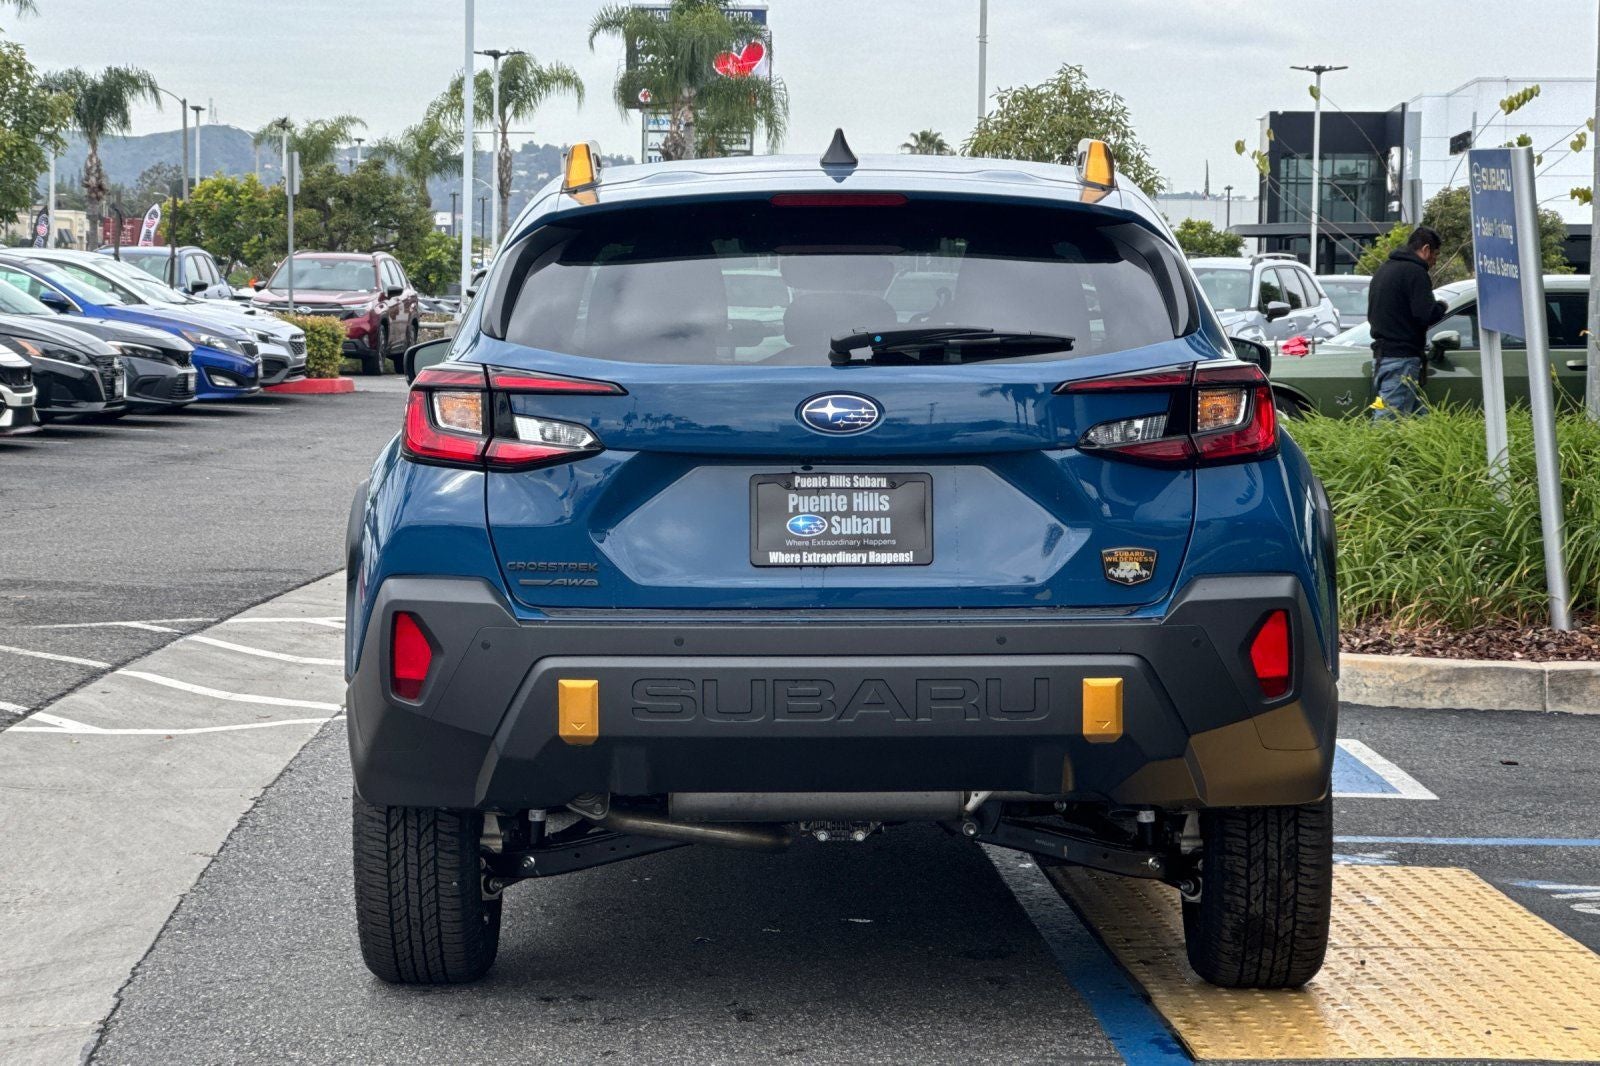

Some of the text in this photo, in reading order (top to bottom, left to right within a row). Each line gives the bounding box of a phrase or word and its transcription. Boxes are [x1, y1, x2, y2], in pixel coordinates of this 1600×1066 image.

[1481, 168, 1512, 192] SUBARU
[1483, 255, 1496, 275] Parts
[1501, 257, 1519, 279] Service
[794, 475, 887, 488] Puente Hills Subaru
[788, 491, 890, 513] Puente Hills
[830, 515, 891, 535] Subaru
[785, 538, 896, 547] Where Extraordinary Happens
[506, 561, 599, 572] CROSSTREK
[769, 551, 914, 565] Where Extraordinary Happens!
[550, 578, 599, 586] AWD
[631, 677, 1050, 722] SUBARU
